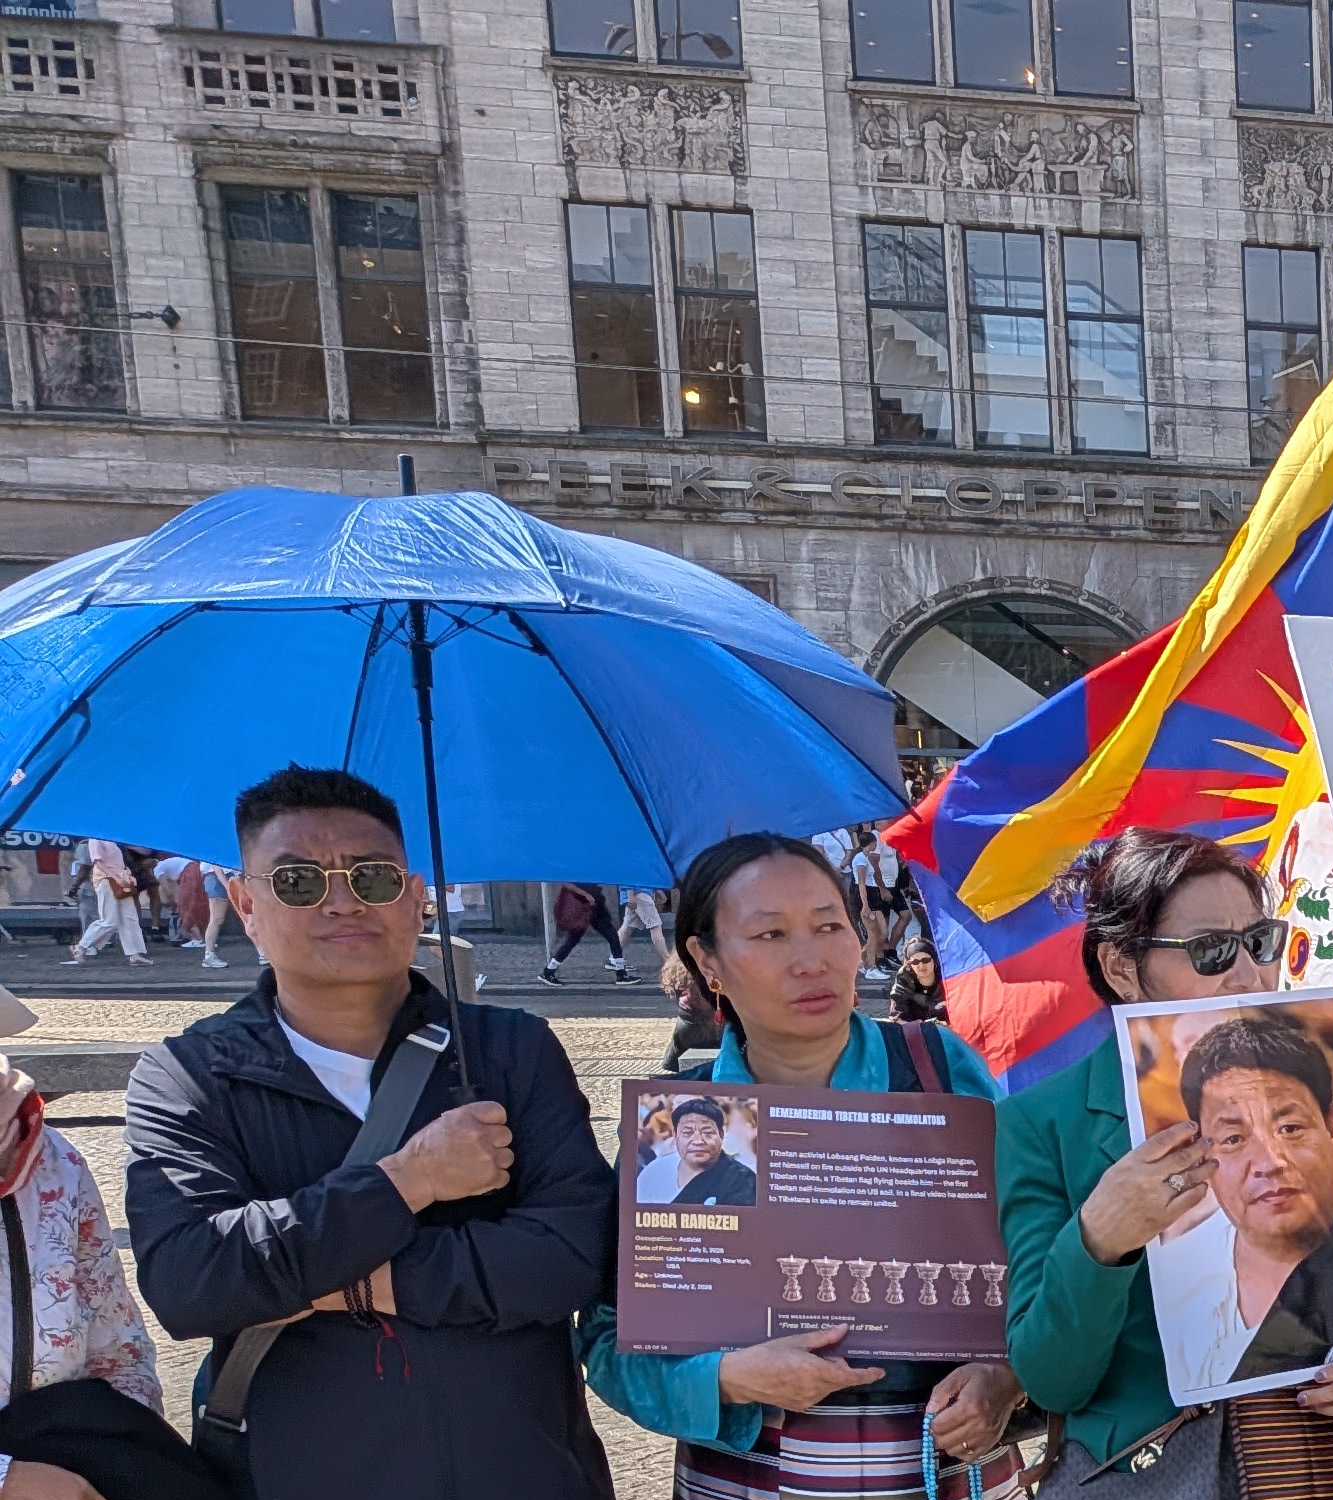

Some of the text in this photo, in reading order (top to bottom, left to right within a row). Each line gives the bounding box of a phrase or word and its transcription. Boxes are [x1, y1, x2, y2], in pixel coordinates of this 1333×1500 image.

[482, 456, 721, 502] PEEK
[744, 465, 811, 510] &
[769, 1106, 833, 1121] REMEMBERING
[834, 1110, 869, 1123] TIBETAN
[635, 1211, 739, 1231] LOBGA RANGZEN
